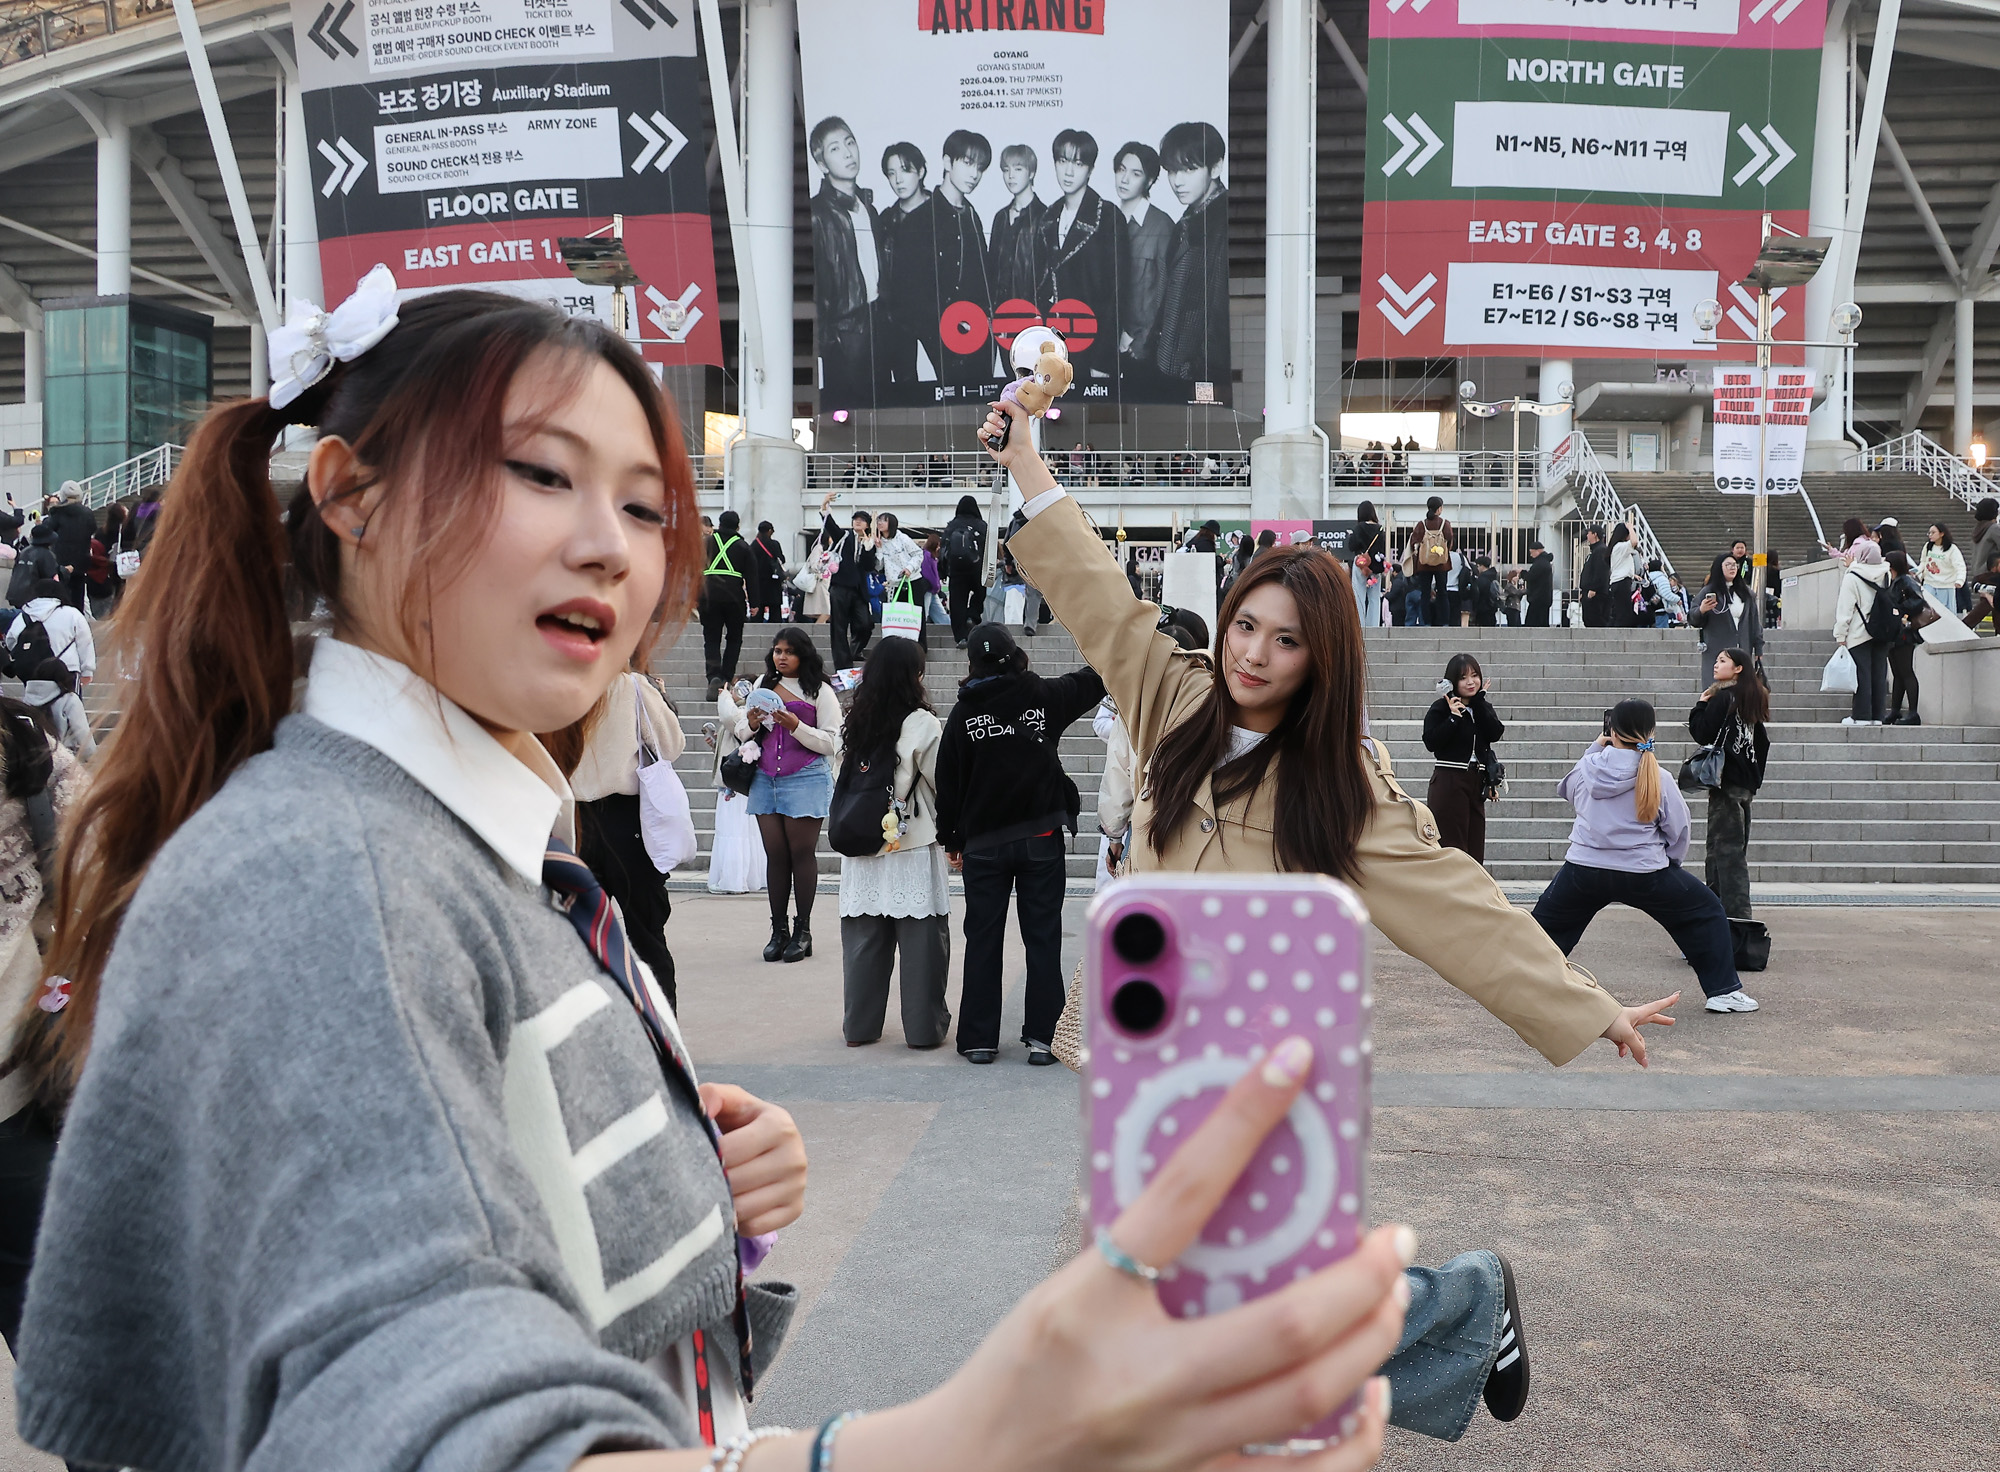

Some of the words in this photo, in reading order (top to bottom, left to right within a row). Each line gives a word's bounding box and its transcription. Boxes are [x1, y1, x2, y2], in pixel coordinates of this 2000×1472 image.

[370, 12, 390, 27] 공식
[392, 9, 412, 24] 앨범
[436, 4, 456, 17] 수령
[459, 1, 480, 15] 부스
[525, 10, 553, 19] TICKET
[555, 10, 573, 18] BOX
[371, 25, 405, 36] OFFICIAL
[406, 21, 432, 32] ALBUM
[432, 18, 461, 28] PICKUP
[463, 15, 492, 25] BOOTH
[372, 41, 392, 56] 앨범
[395, 39, 414, 53] 예약
[417, 34, 445, 50] 구매자
[448, 31, 492, 45] SOUND
[494, 27, 536, 41] CHECK
[538, 25, 572, 38] 이벤트
[574, 23, 596, 38] 부스
[374, 56, 401, 66] ALBUM
[445, 45, 473, 56] SOUND
[475, 42, 503, 53] CHECK
[504, 41, 528, 51] EVENT
[530, 40, 559, 49] BOOTH
[993, 51, 1029, 59] GOYANG
[976, 63, 1010, 72] GOYANG
[1011, 62, 1045, 71] STADIUM
[1507, 58, 1605, 85] NORTH
[1613, 62, 1685, 89] GATE
[960, 76, 1007, 86] 2026.04.09.
[1009, 76, 1025, 84] THU
[1027, 74, 1063, 84] 7PM(KST)
[378, 88, 418, 114] 보조
[421, 79, 482, 111] 경기장
[491, 85, 551, 102] Auxiliary
[554, 82, 611, 98] Stadium
[961, 88, 1009, 98] 2026.04.11.
[1010, 88, 1024, 96] SAT
[1025, 87, 1062, 96] 7PM(KST)
[960, 101, 1008, 110] 2026.04.12.
[1027, 100, 1064, 109] 7PM(KST)
[527, 118, 562, 131] ARMY
[565, 117, 597, 130] ZONE
[385, 129, 436, 144] GENERAL
[437, 124, 485, 138] IN-PASS
[487, 122, 508, 135] 부스
[385, 145, 421, 155] GENERAL
[450, 138, 477, 148] BOOTH
[1496, 135, 1567, 158] N1~N5,
[1571, 137, 1648, 157] N6~N11
[1653, 140, 1687, 161] 구역
[387, 159, 428, 173] SOUND
[481, 151, 503, 165] 전용
[505, 150, 524, 163] 부스
[388, 174, 416, 184] SOUND
[417, 171, 442, 181] CHECK
[443, 169, 469, 179] BOOTH
[427, 191, 509, 220] FLOOR
[514, 187, 579, 212] GATE
[1468, 220, 1538, 244] EAST
[1545, 222, 1617, 248] GATE
[1623, 226, 1647, 254] 3,
[1654, 228, 1677, 255] 4,
[1684, 229, 1702, 251] 8
[404, 244, 462, 270] EAST
[468, 239, 534, 264] GATE
[541, 238, 562, 264] 1,
[1492, 283, 1554, 301] E1~E6
[1558, 284, 1567, 303] /
[1570, 286, 1632, 304] S1~S3
[1637, 287, 1671, 308] 구역
[563, 295, 595, 315] 구역
[1483, 307, 1556, 325] E7~E12
[1561, 309, 1569, 327] /
[1573, 311, 1639, 329] S6~S8
[1644, 312, 1678, 332] 구역
[1727, 374, 1747, 386] BTS
[1782, 374, 1802, 386] BTS
[1720, 387, 1755, 399] WORLD
[1774, 387, 1807, 399] WORLD
[1725, 401, 1750, 412] TOUR
[1777, 401, 1800, 412] TOUR
[1715, 412, 1761, 425] ARIRANG
[1767, 413, 1808, 425] ARIRANG
[1318, 531, 1346, 539] FLOOR
[1321, 541, 1343, 549] GATE
[967, 728, 986, 742] TO
